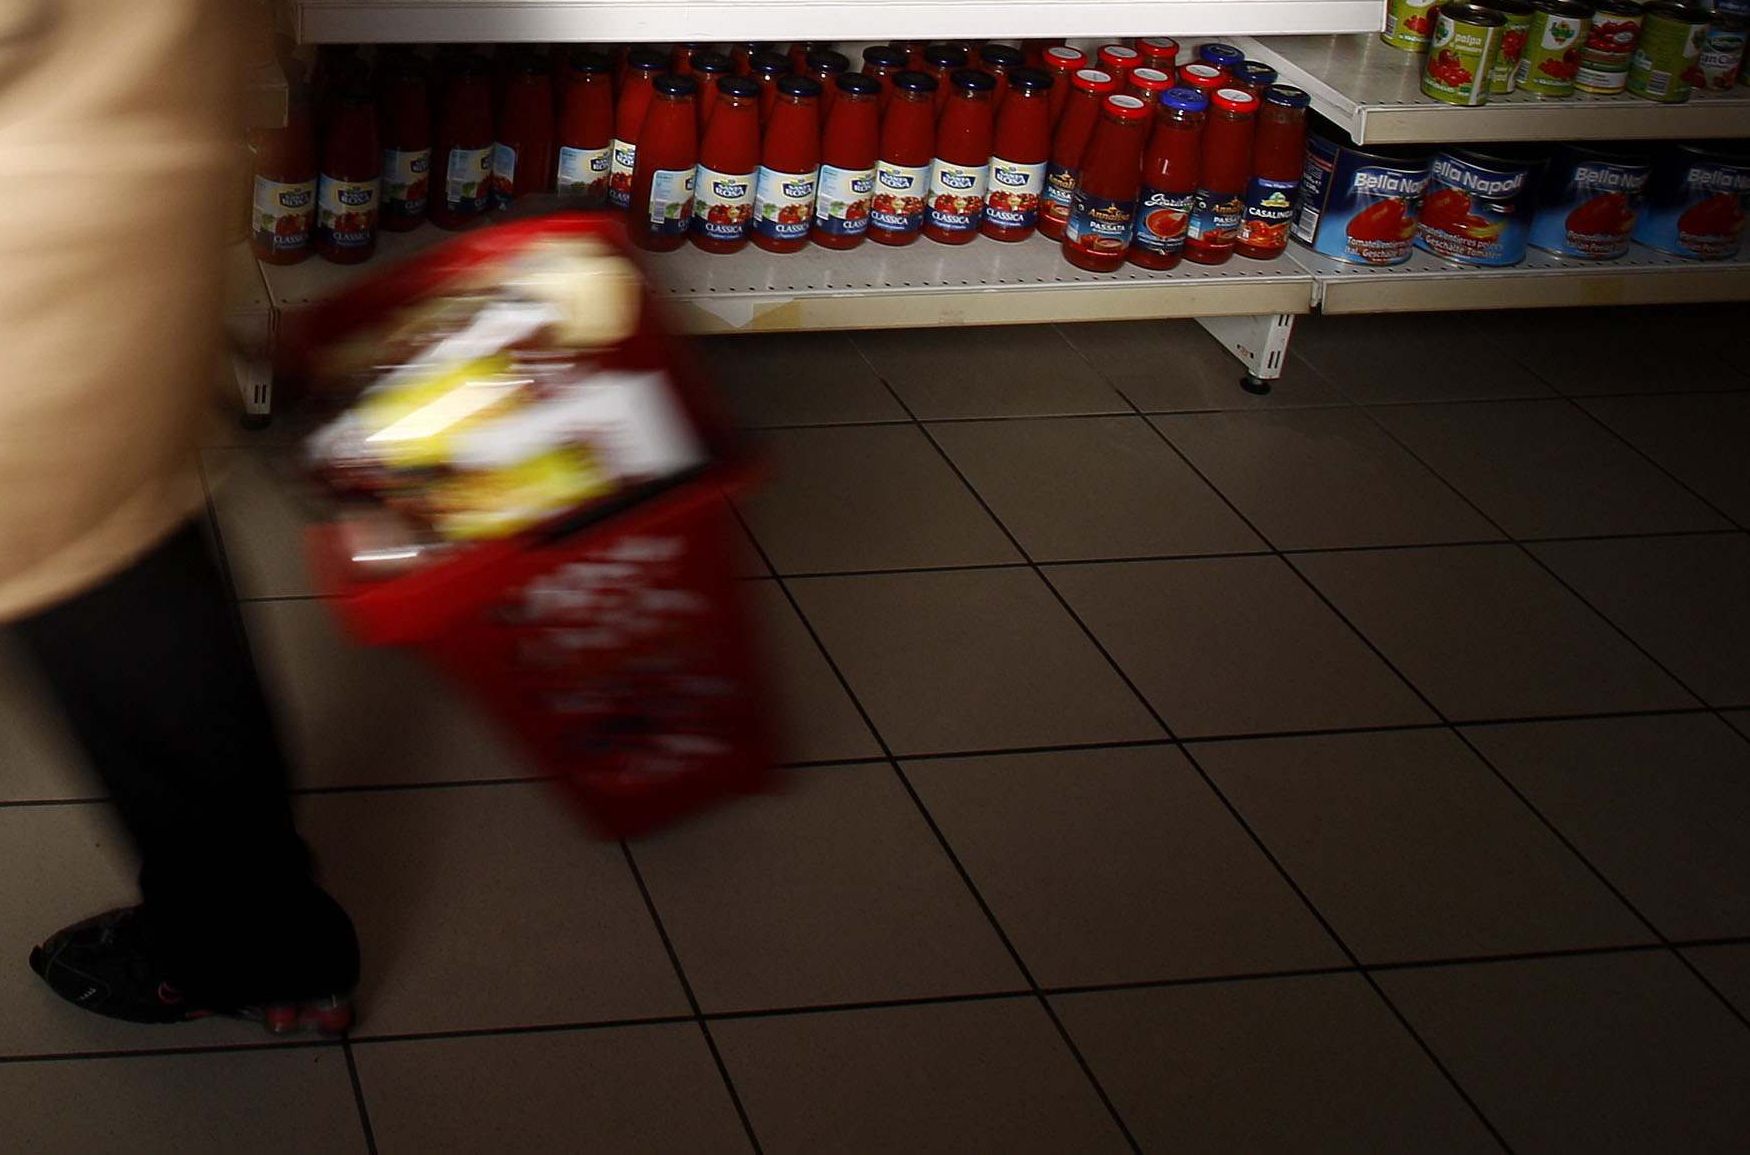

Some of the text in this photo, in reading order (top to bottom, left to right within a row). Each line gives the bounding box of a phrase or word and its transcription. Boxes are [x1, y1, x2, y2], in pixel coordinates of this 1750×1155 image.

[881, 173, 913, 182] SANTA
[943, 173, 975, 182] SANTA
[997, 170, 1030, 179] SANTA
[1575, 167, 1616, 185] Bella
[1687, 169, 1724, 187] Bella
[716, 182, 746, 190] SANTA
[881, 180, 911, 189] ROSA
[943, 180, 974, 189] ROSA
[996, 177, 1029, 186] ROSA
[1355, 172, 1398, 190] Bella
[1465, 173, 1524, 191] Napoli
[715, 188, 746, 197] ROSA
[784, 188, 813, 197] ROSA
[871, 211, 909, 225] CLASSICA
[932, 211, 970, 225] CLASSICA
[986, 208, 1024, 223] CLASSICA
[706, 223, 743, 234] CLASSICA
[1090, 221, 1126, 232] PASSATA
